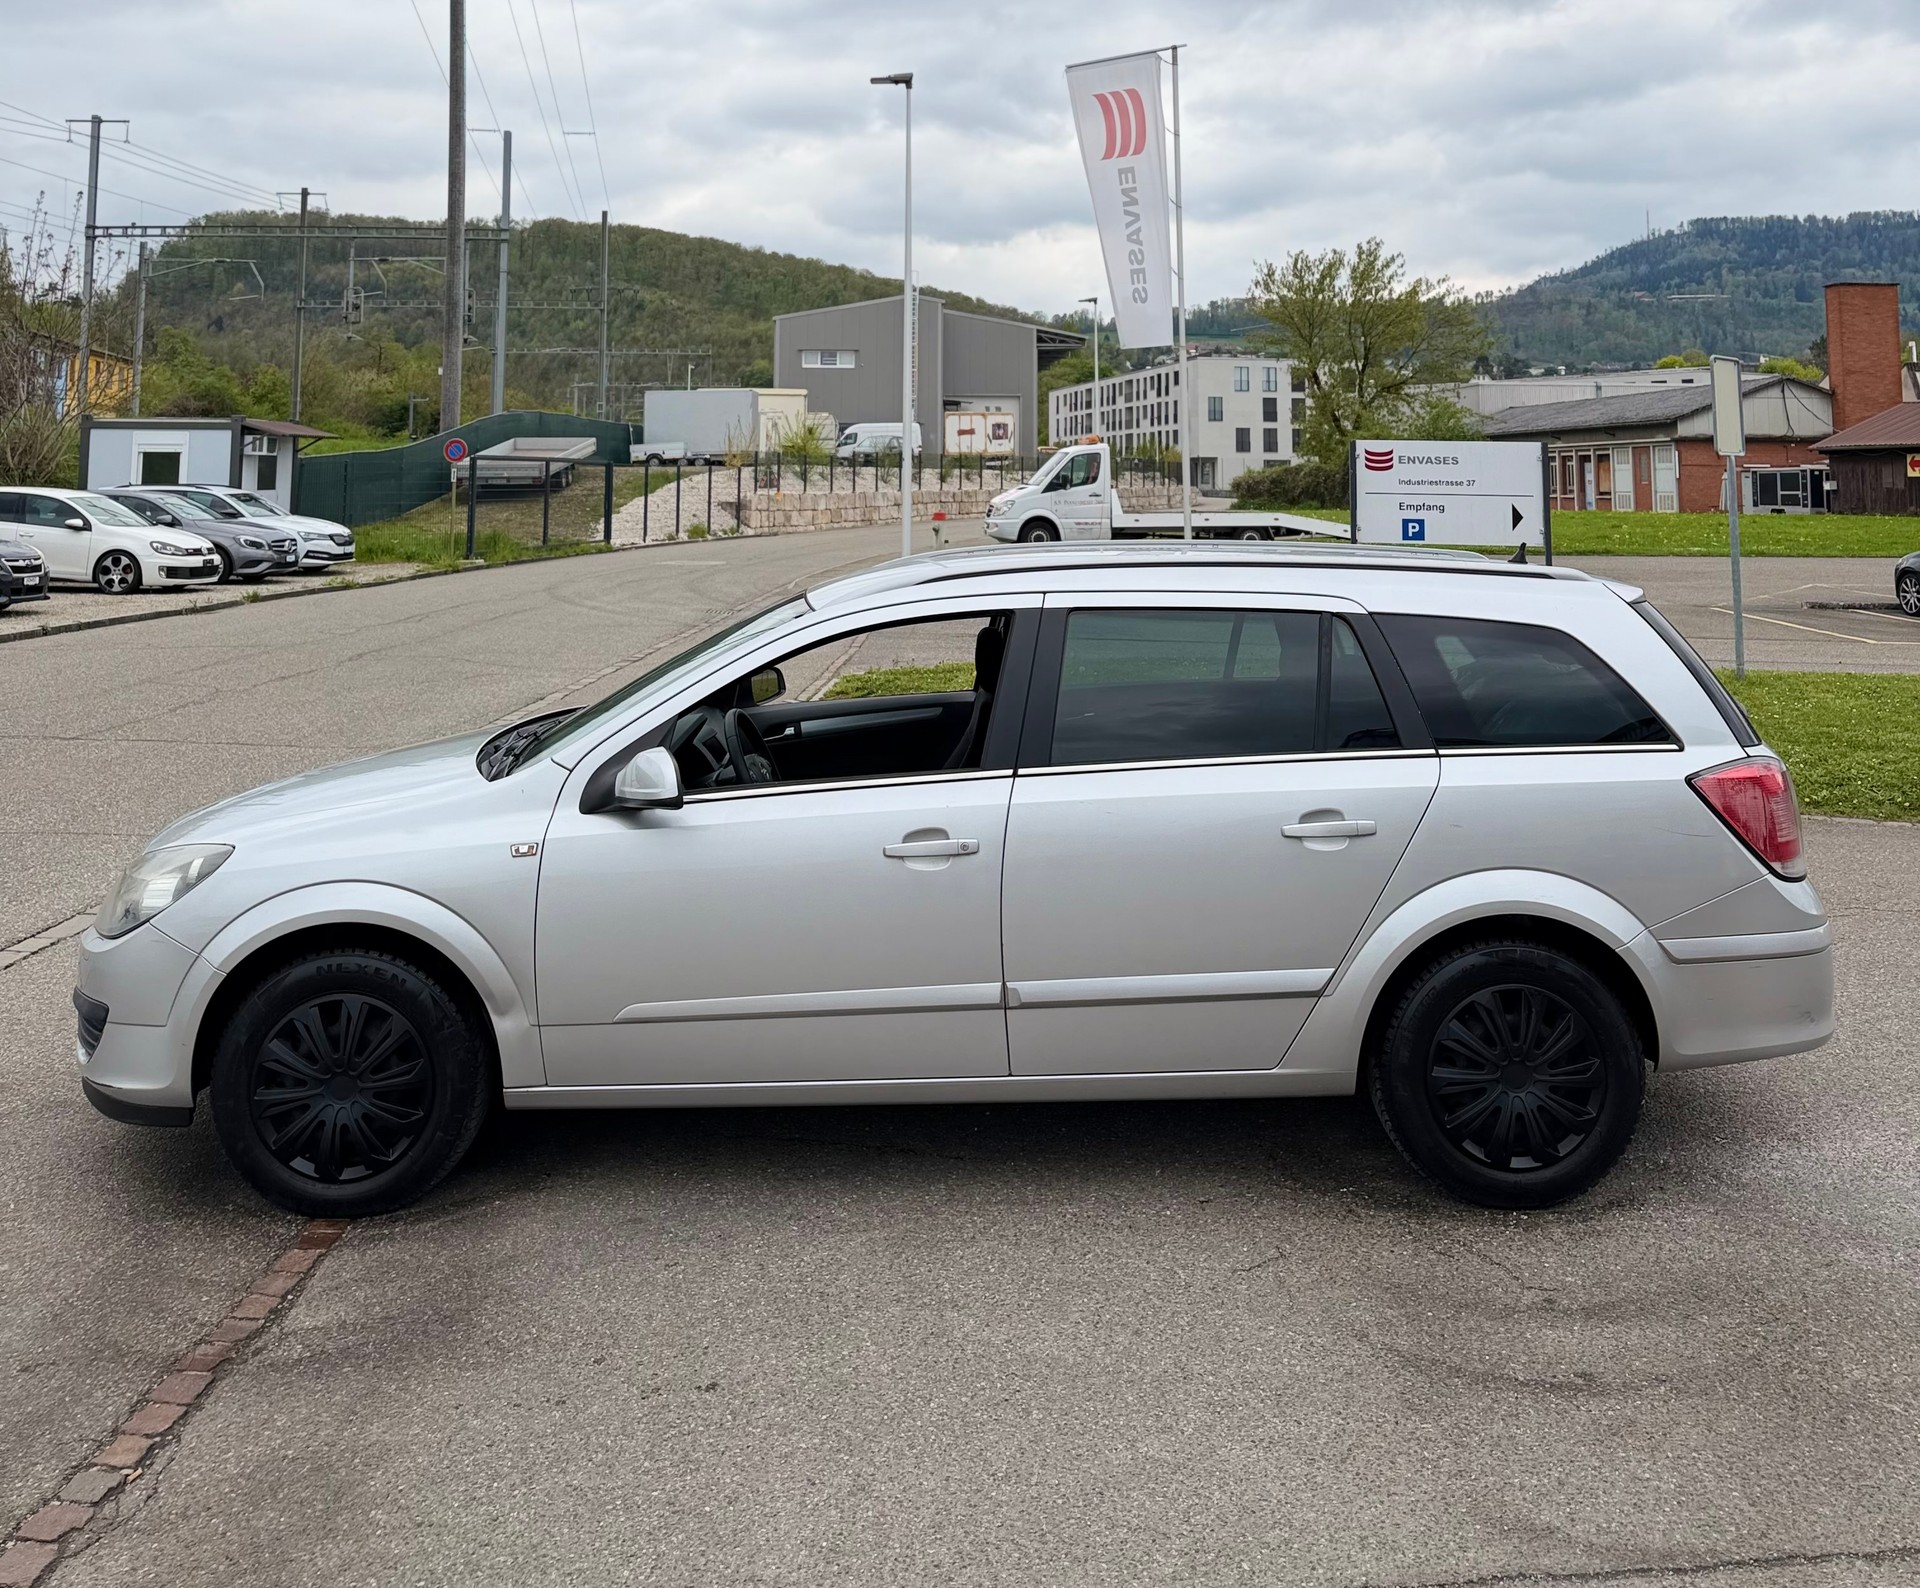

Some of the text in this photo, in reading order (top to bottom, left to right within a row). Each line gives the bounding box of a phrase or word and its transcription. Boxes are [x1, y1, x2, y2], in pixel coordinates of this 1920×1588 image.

[1398, 455, 1459, 465] ENVASES
[1398, 478, 1476, 487] Industriestrasse 37
[1399, 502, 1445, 513] Empfang
[1408, 522, 1420, 537] P
[316, 962, 407, 988] NEXEN
